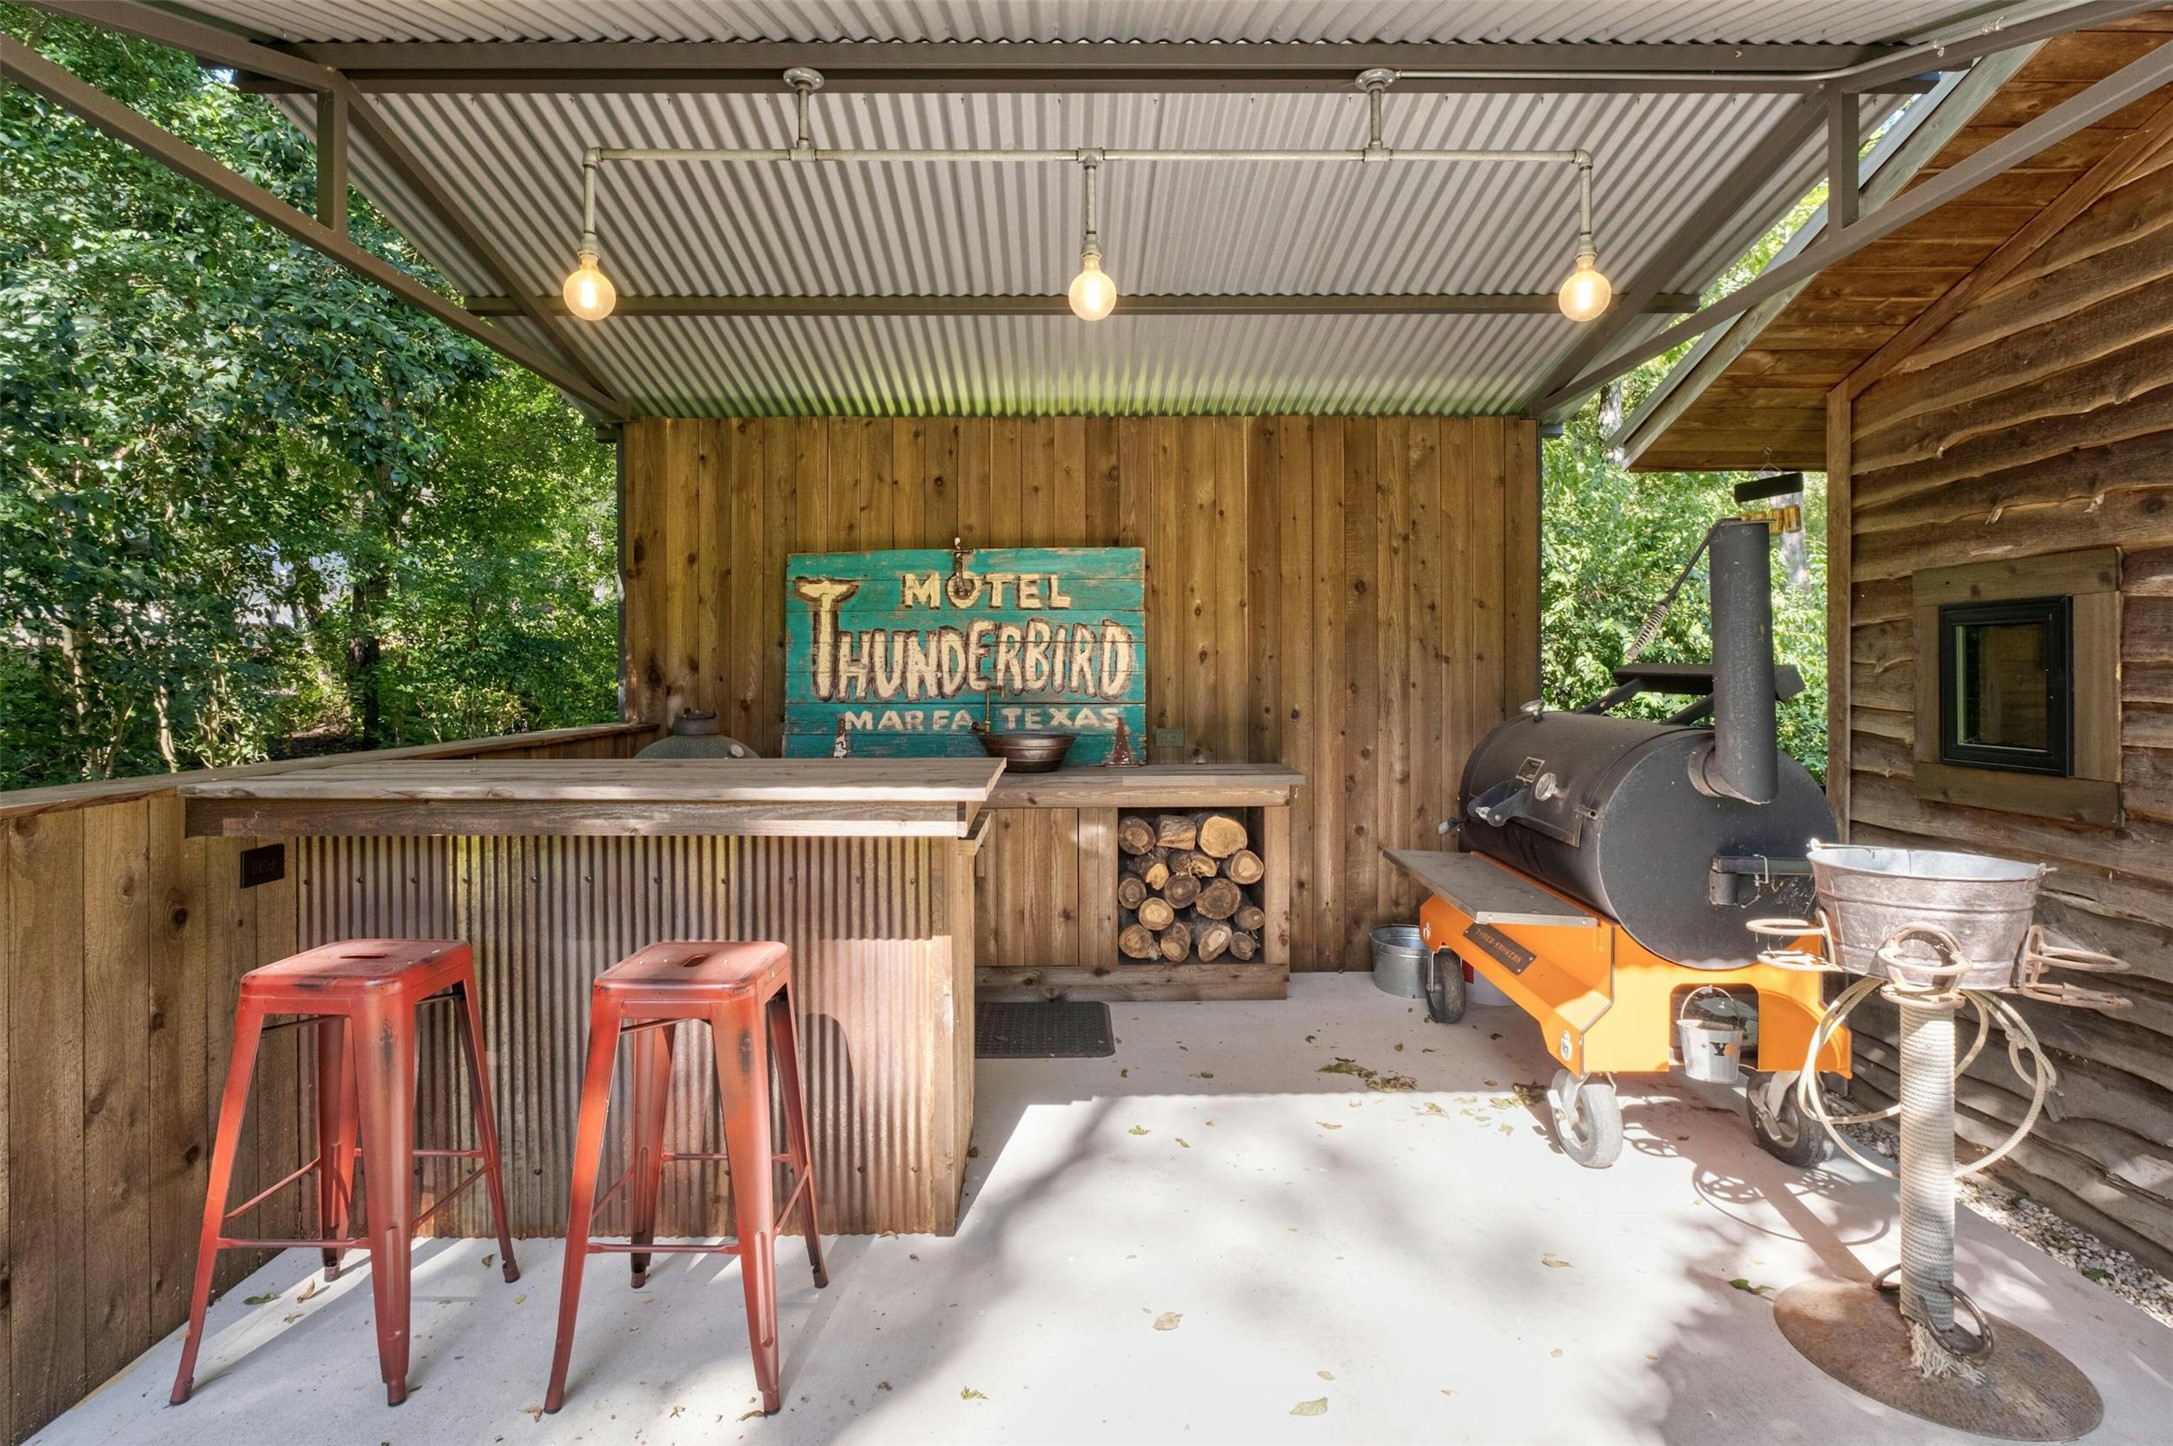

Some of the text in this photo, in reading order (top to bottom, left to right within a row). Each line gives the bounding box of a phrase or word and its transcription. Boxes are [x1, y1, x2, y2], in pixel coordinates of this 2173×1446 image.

[902, 571, 1072, 610] MOTEL
[796, 577, 1133, 701] THUNDERBIRD
[844, 707, 1119, 731] MARFA TEXAS
